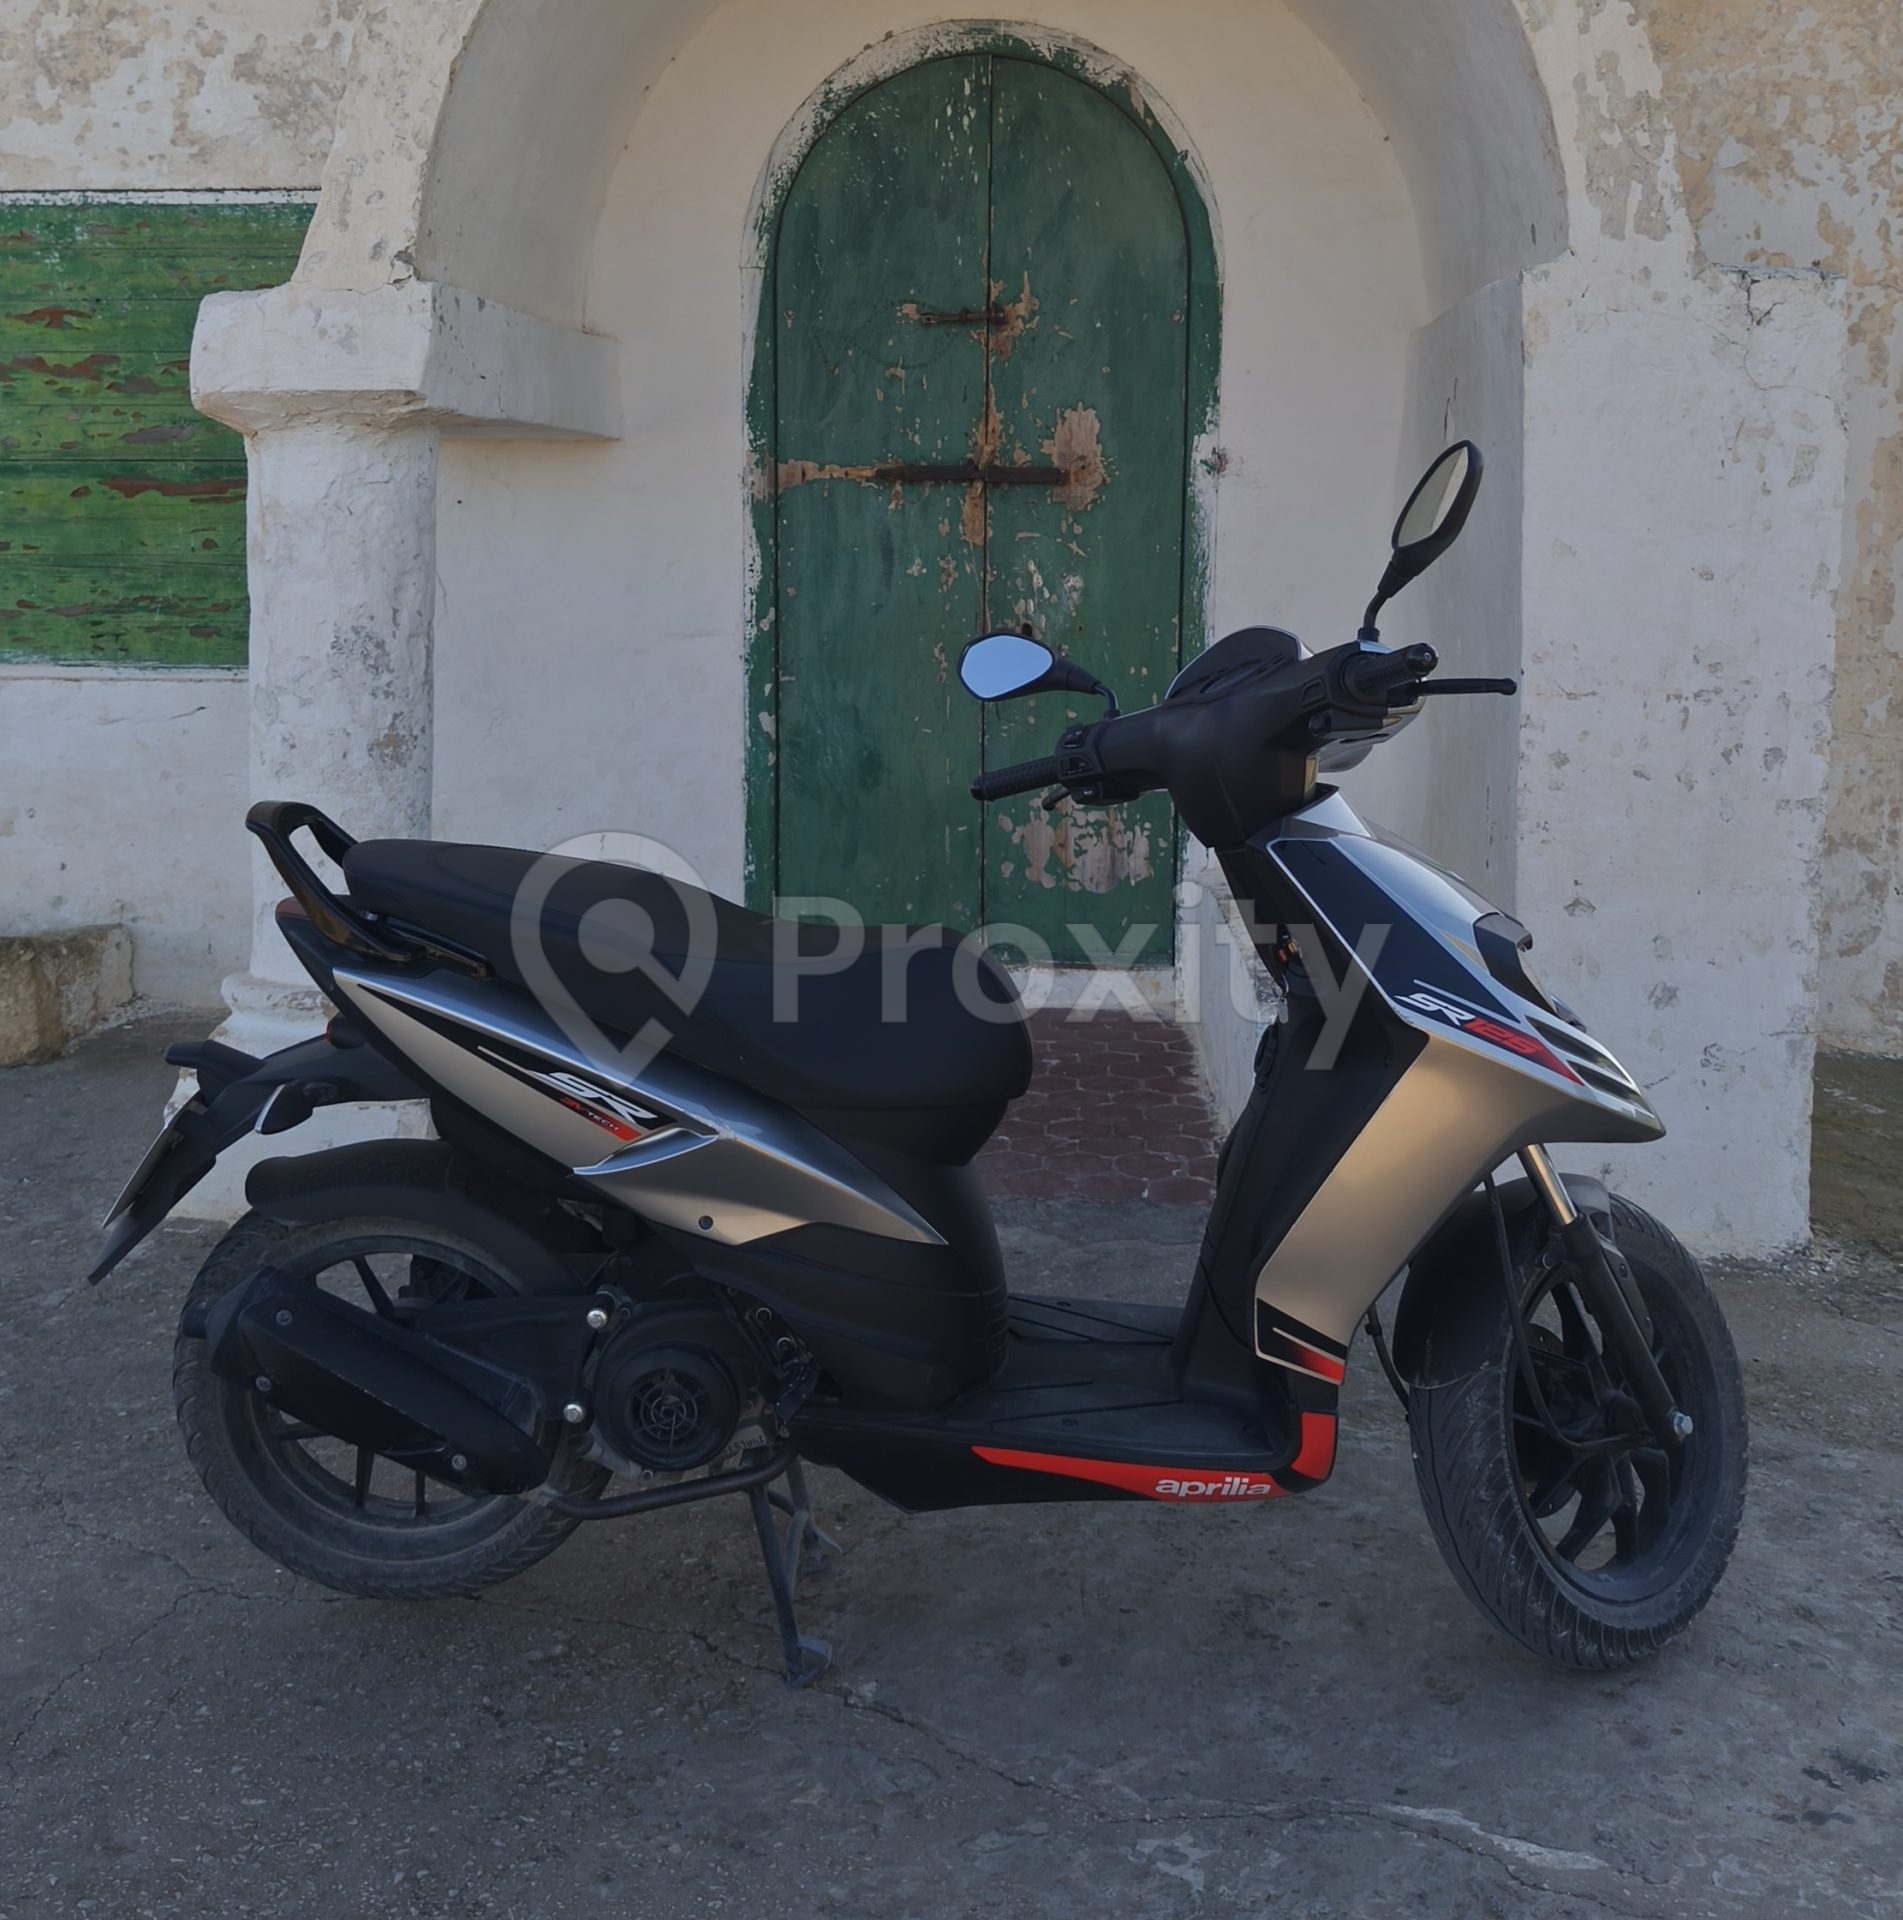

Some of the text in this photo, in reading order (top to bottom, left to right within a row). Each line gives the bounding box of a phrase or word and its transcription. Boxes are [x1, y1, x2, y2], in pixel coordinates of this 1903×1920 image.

[1393, 993, 1477, 1027] SR
[530, 1071, 659, 1125] SR
[1155, 1477, 1271, 1497] aprilia
